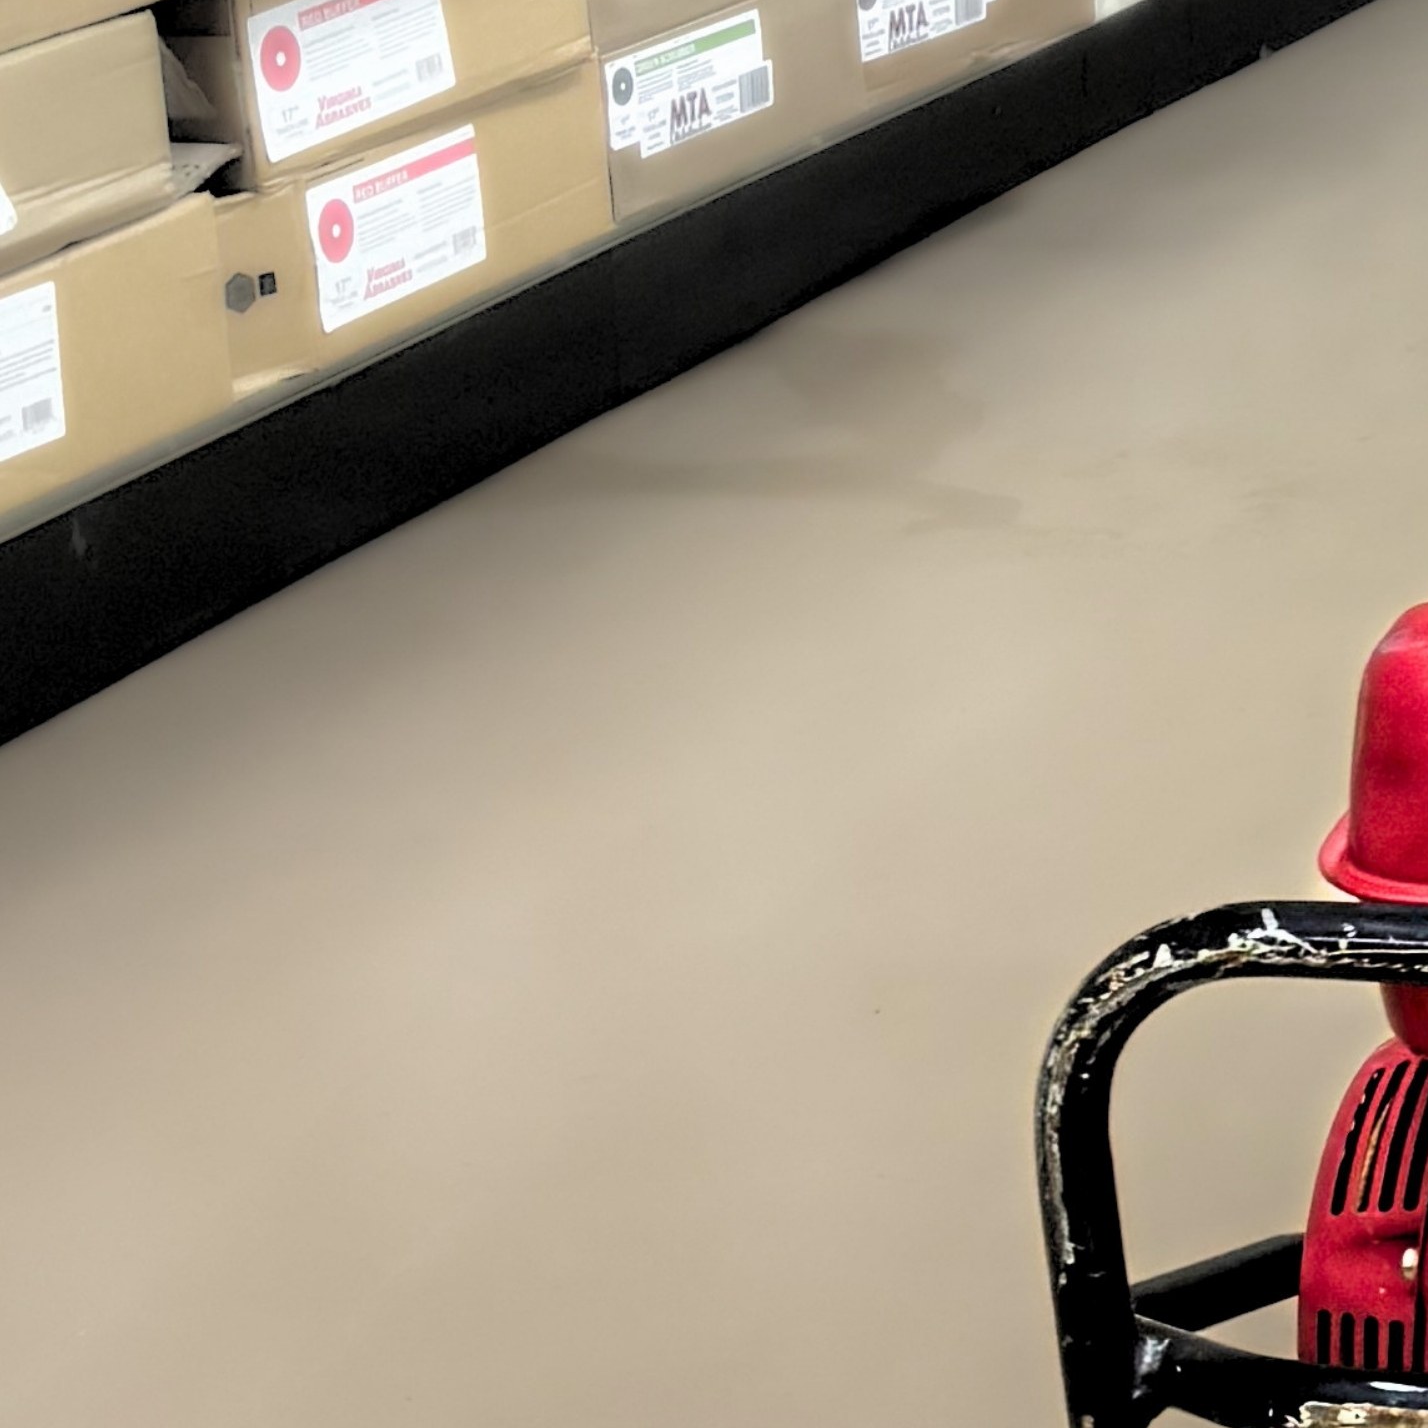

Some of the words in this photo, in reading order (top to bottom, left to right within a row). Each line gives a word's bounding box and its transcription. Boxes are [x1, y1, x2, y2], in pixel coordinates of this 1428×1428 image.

[890, 0, 929, 39] MTA
[315, 97, 372, 130] ABRASIVES
[671, 87, 712, 127] MTA
